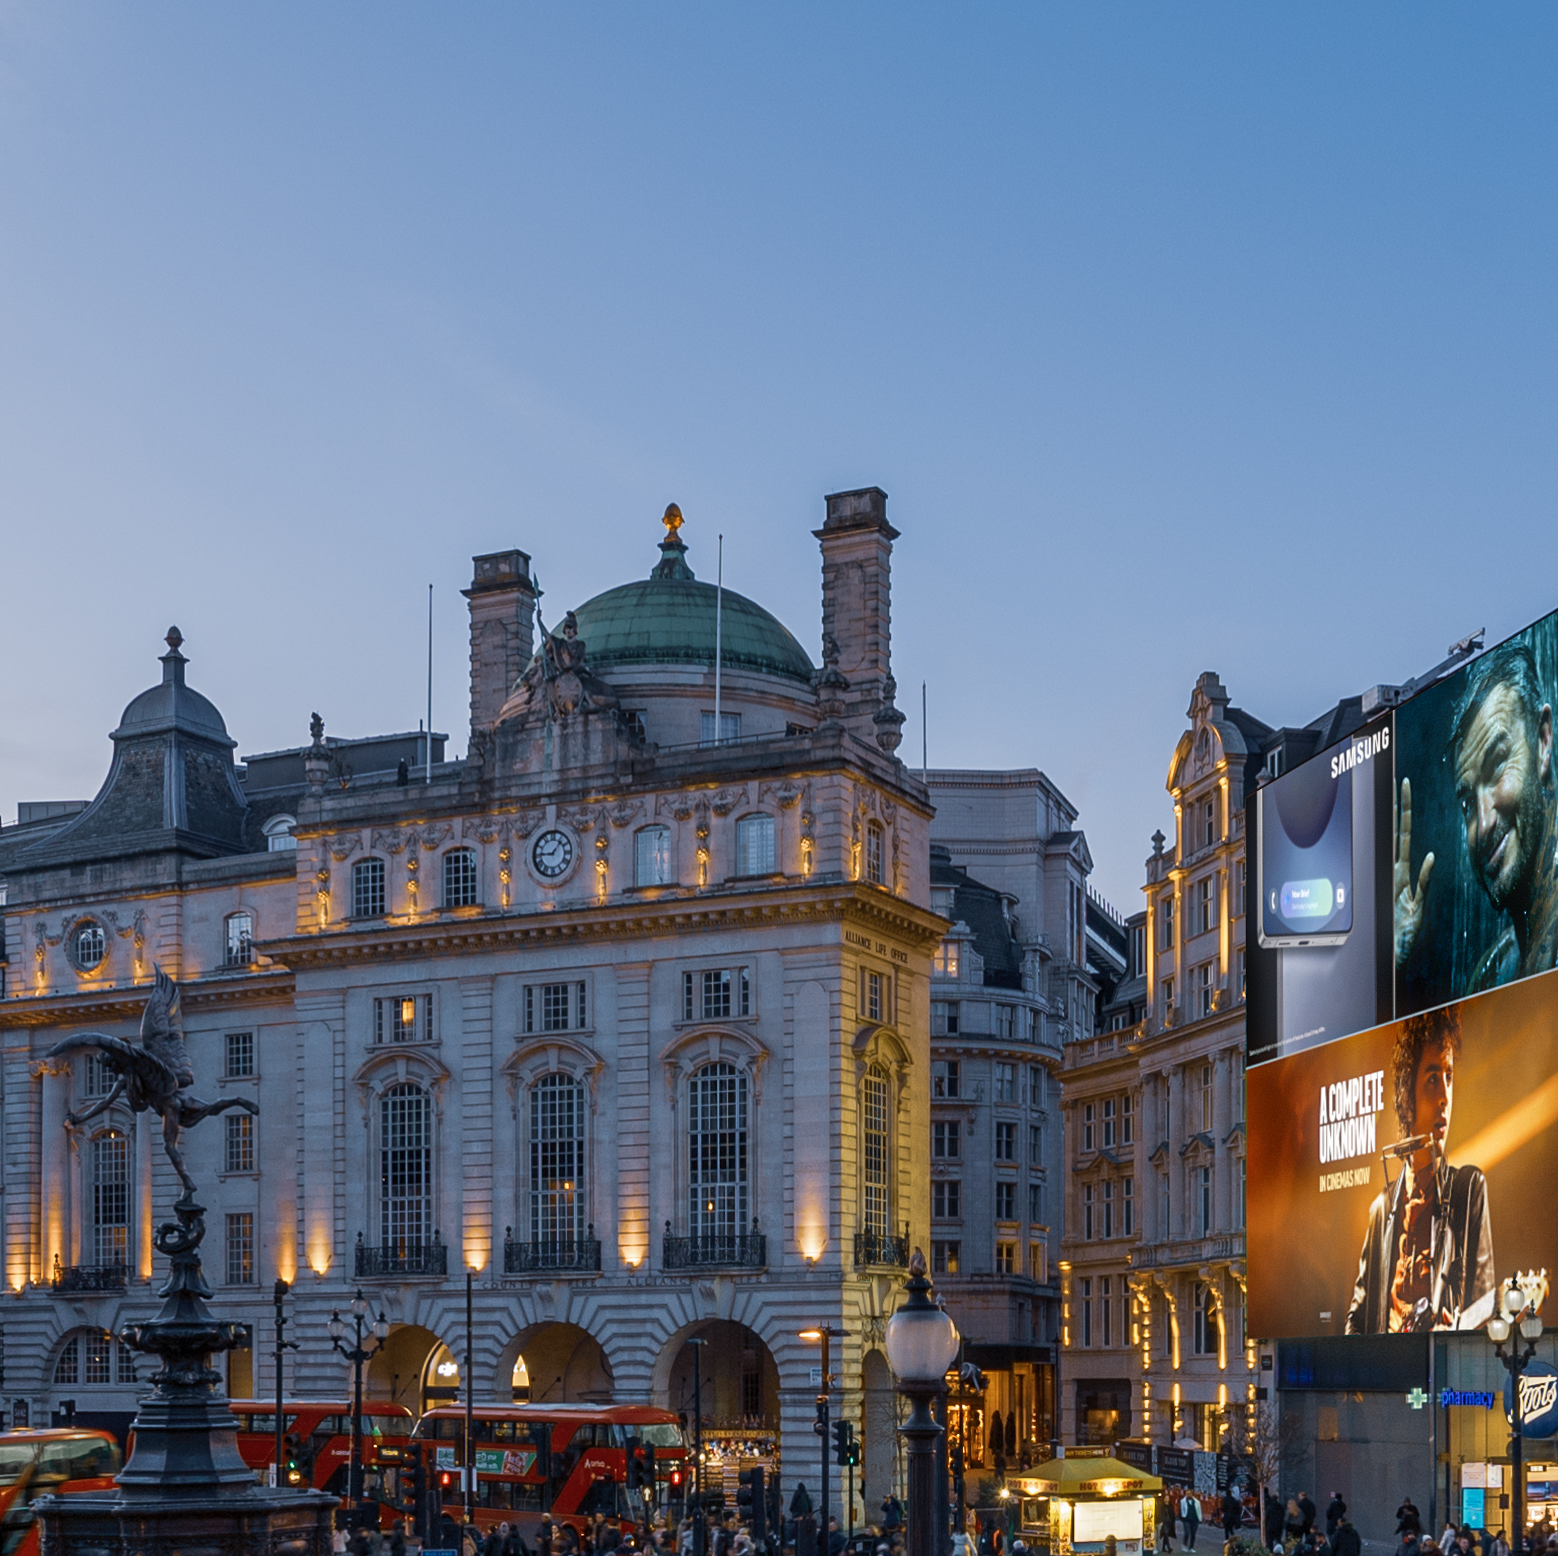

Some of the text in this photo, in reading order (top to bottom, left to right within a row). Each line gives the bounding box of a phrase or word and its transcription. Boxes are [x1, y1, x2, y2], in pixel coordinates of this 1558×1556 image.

[1331, 727, 1390, 779] SAMSUNG
[1319, 1070, 1384, 1125] A COMPLETE
[1319, 1113, 1376, 1164] UNKNOWN
[1319, 1166, 1370, 1193] IN CINEMAS NOW
[1442, 1388, 1494, 1410] pharmacy
[1007, 1479, 1022, 1488] HOT
[1080, 1482, 1097, 1491] HOT
[1121, 1480, 1143, 1489] SPOT
